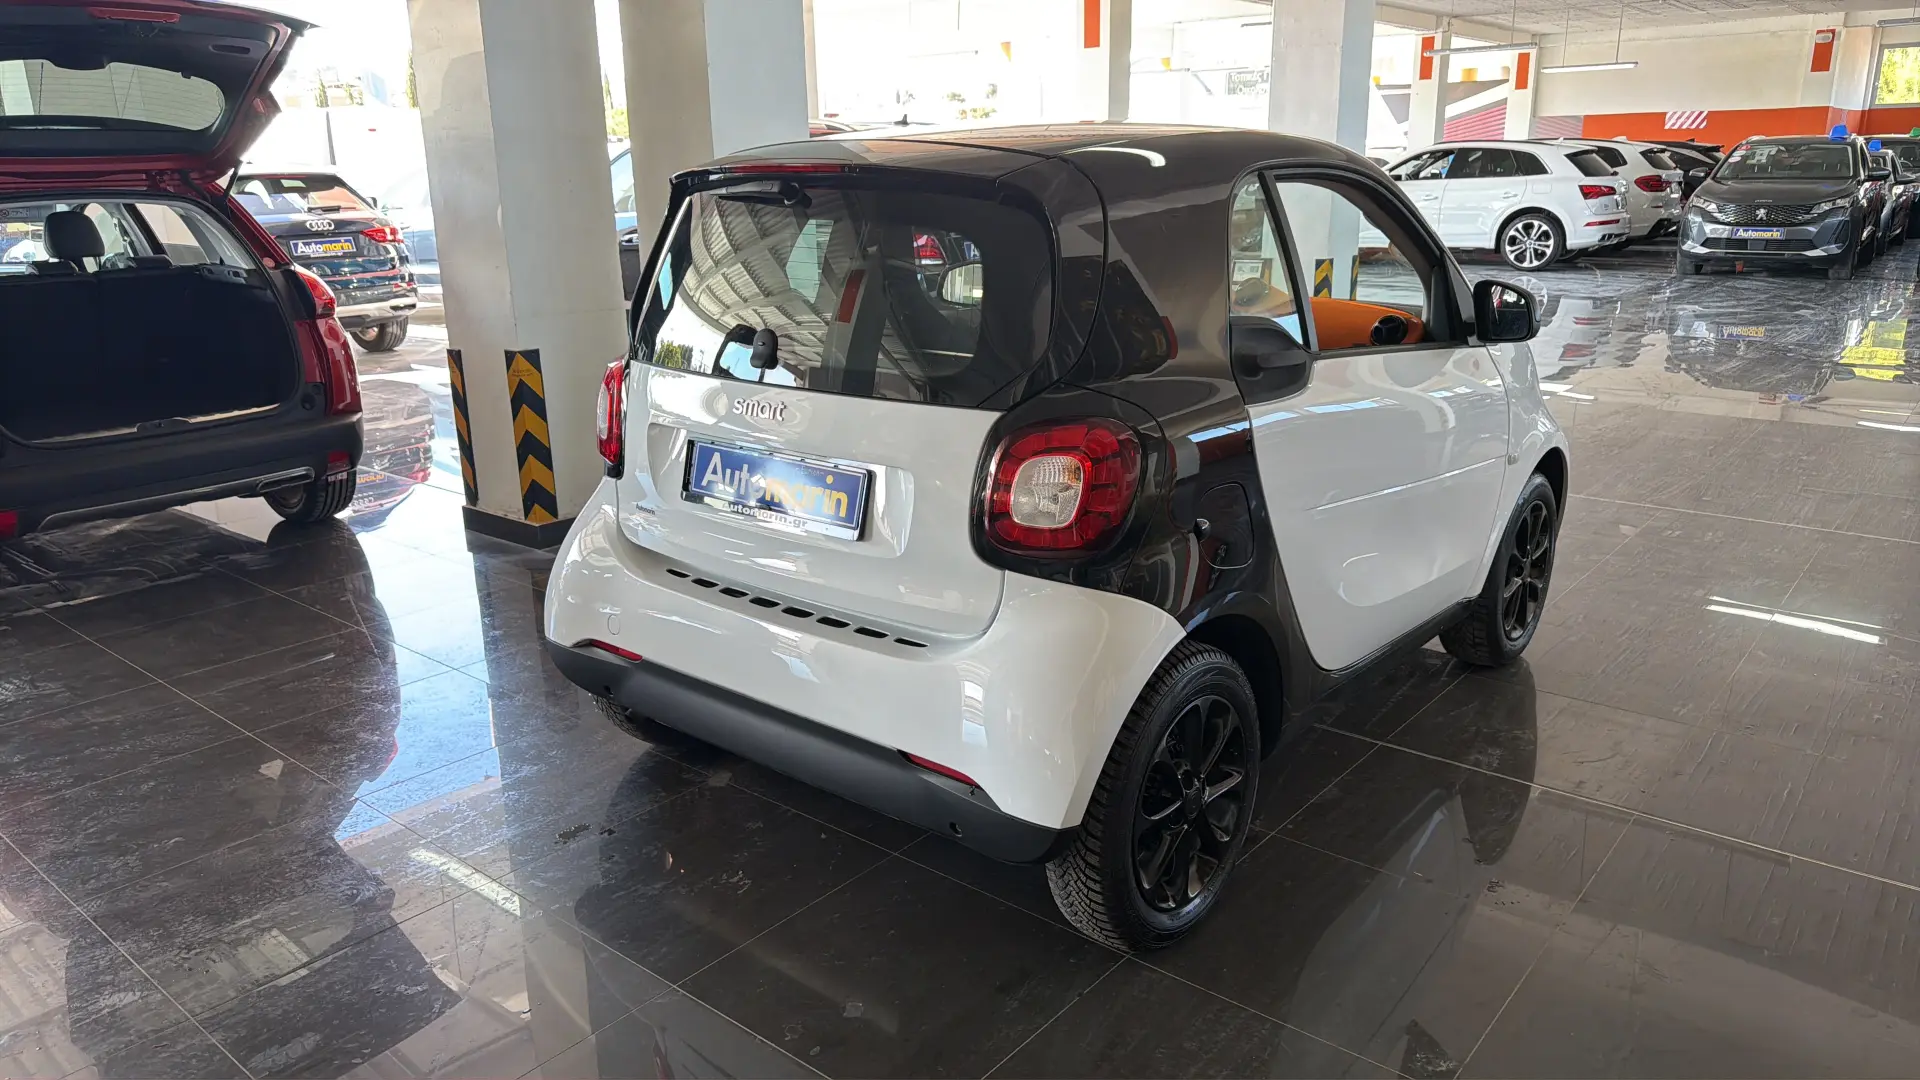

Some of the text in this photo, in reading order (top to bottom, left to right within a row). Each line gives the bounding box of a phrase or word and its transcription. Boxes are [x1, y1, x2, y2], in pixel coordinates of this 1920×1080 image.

[1736, 228, 1780, 237] Automarin
[297, 239, 352, 253] Automarin
[733, 398, 786, 421] smart
[701, 452, 848, 518] Automarin
